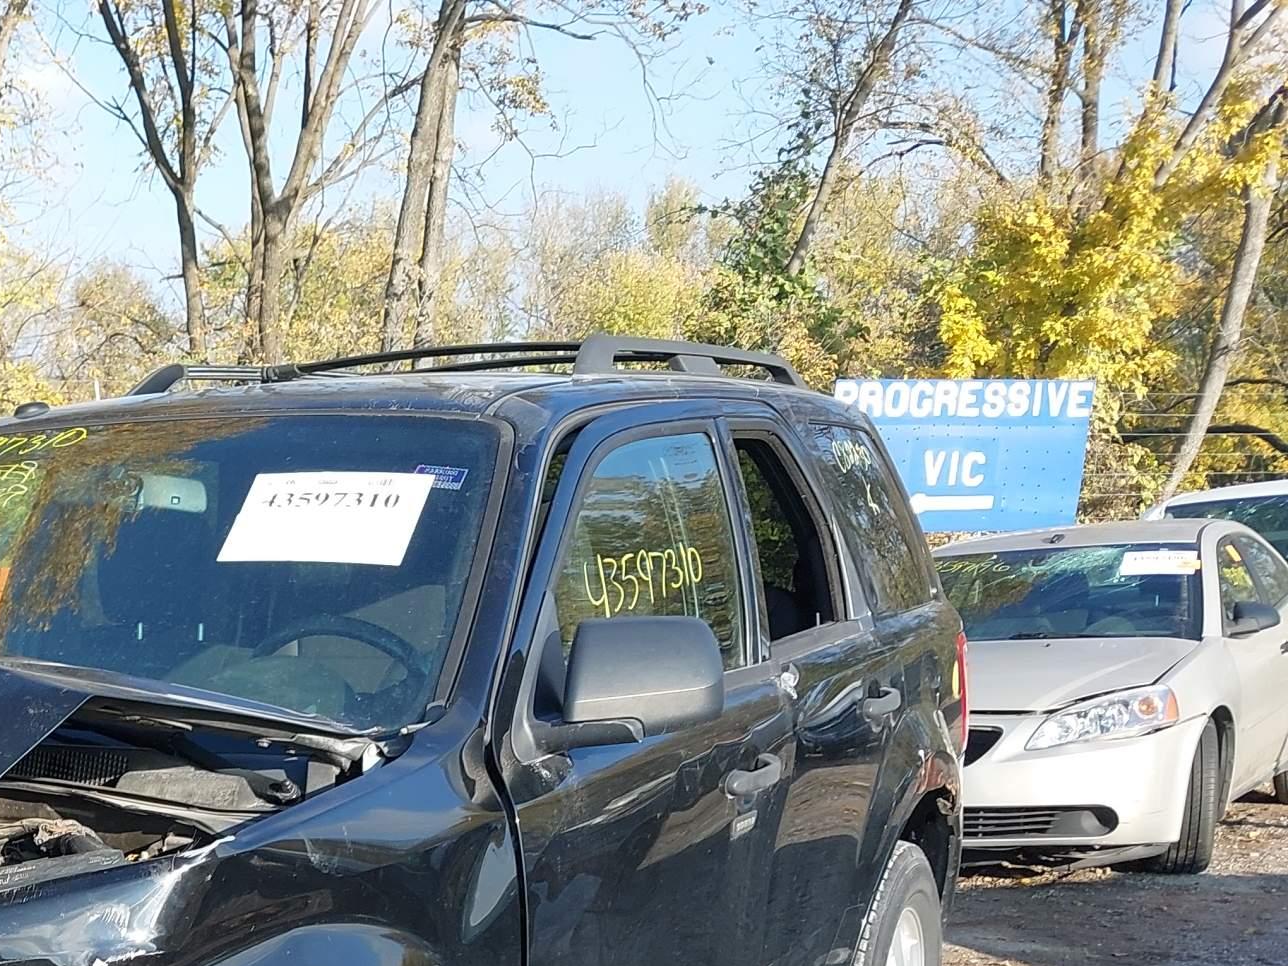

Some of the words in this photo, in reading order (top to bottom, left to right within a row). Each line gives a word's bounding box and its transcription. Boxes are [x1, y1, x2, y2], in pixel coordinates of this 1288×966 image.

[833, 381, 1095, 418] PROGRESSIVE
[924, 449, 987, 488] VIC
[262, 492, 401, 508] 43597310
[583, 541, 703, 619] 43597310
